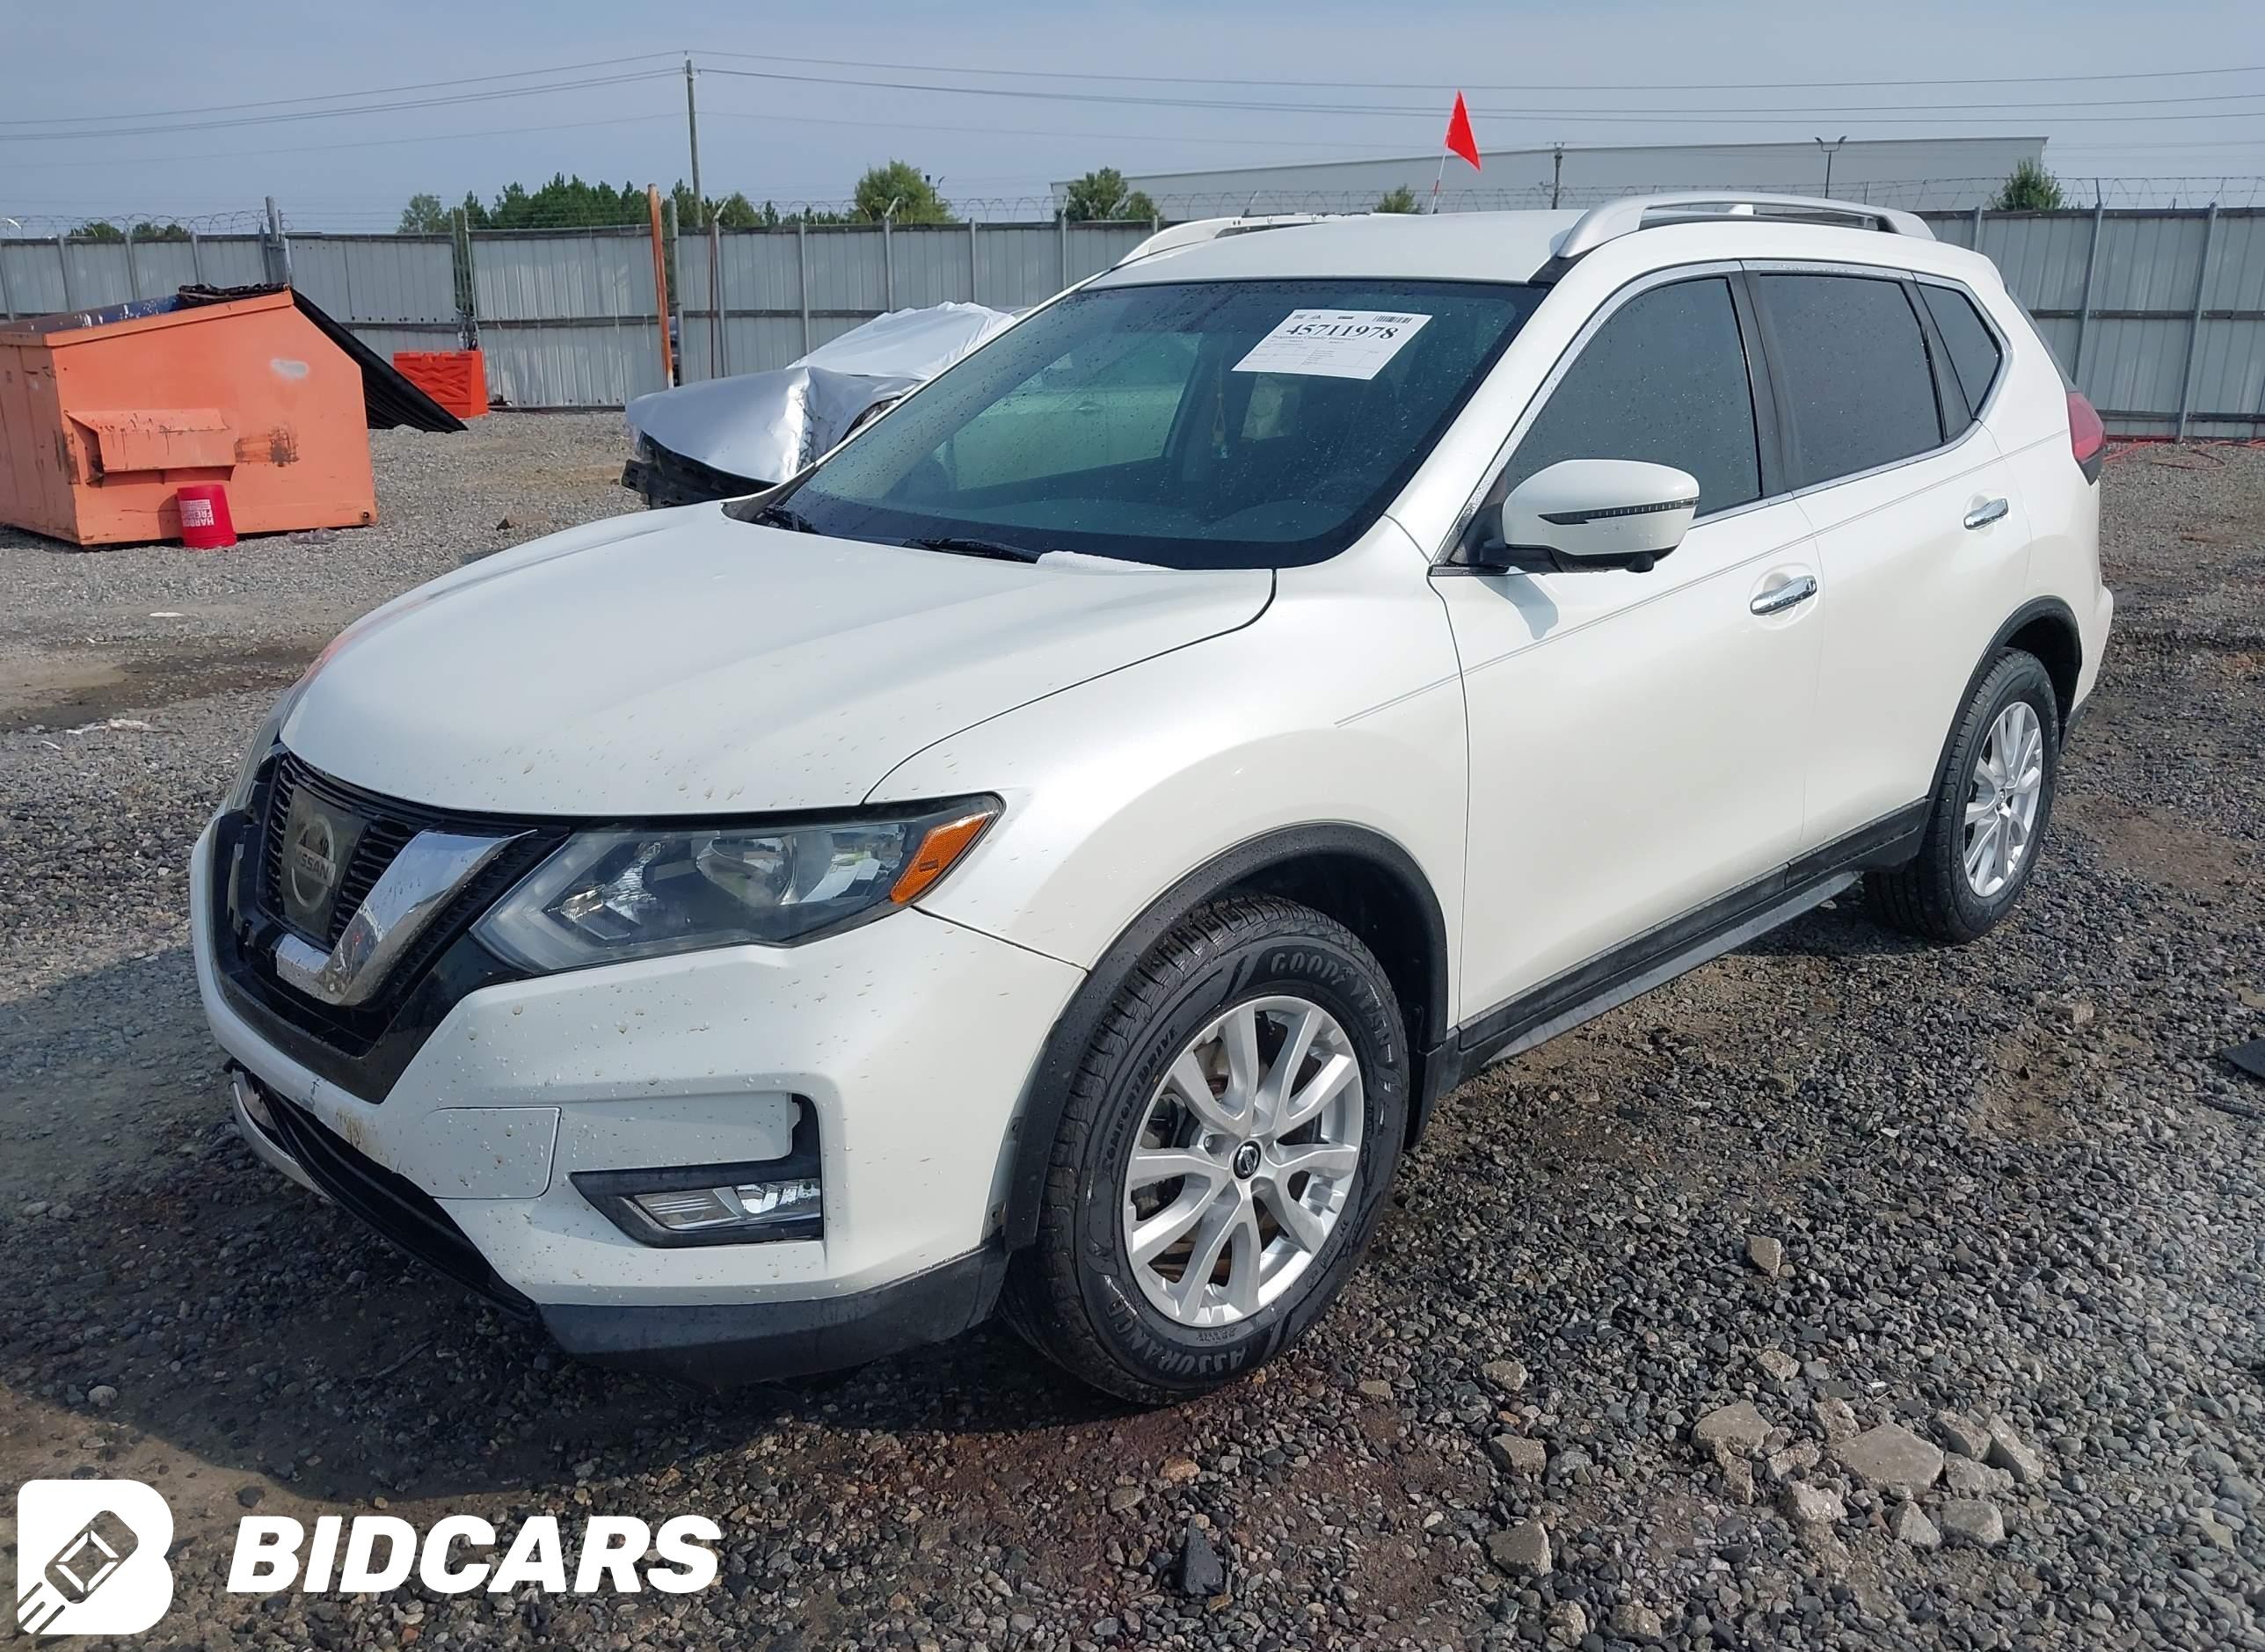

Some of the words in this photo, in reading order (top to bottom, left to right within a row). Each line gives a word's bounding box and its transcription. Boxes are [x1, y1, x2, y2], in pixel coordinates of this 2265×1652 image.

[1286, 324, 1399, 339] 45711978
[181, 509, 212, 519] FREIG
[296, 850, 329, 879] SSAN
